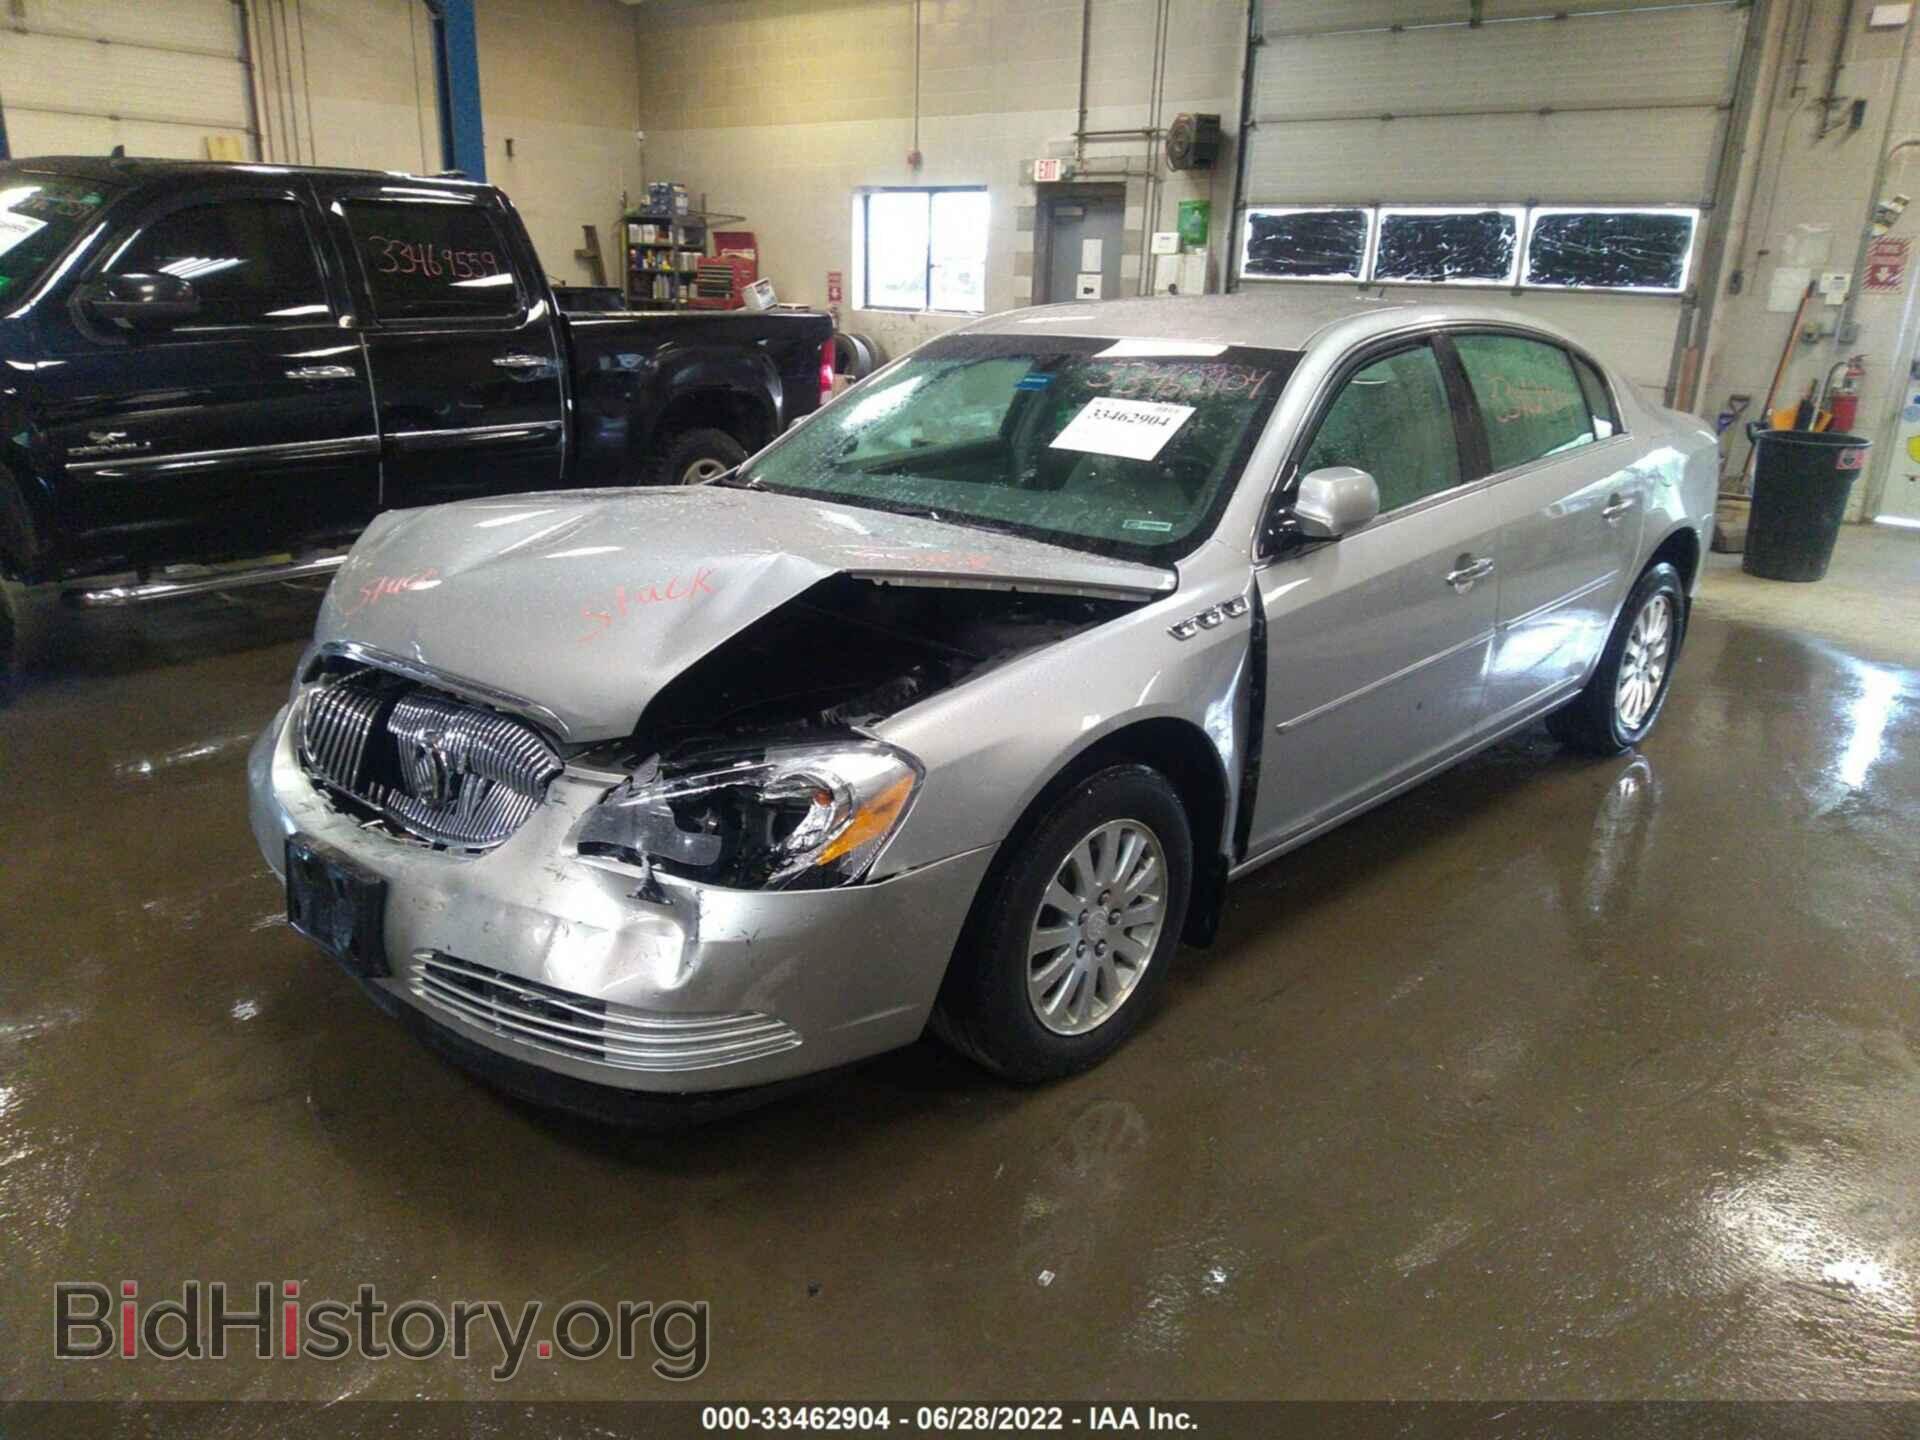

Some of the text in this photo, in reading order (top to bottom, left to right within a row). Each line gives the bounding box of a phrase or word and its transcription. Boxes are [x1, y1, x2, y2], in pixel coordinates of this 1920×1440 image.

[1038, 160, 1057, 179] EXIT
[369, 235, 499, 279] 33469559
[1087, 407, 1171, 427] 33462904
